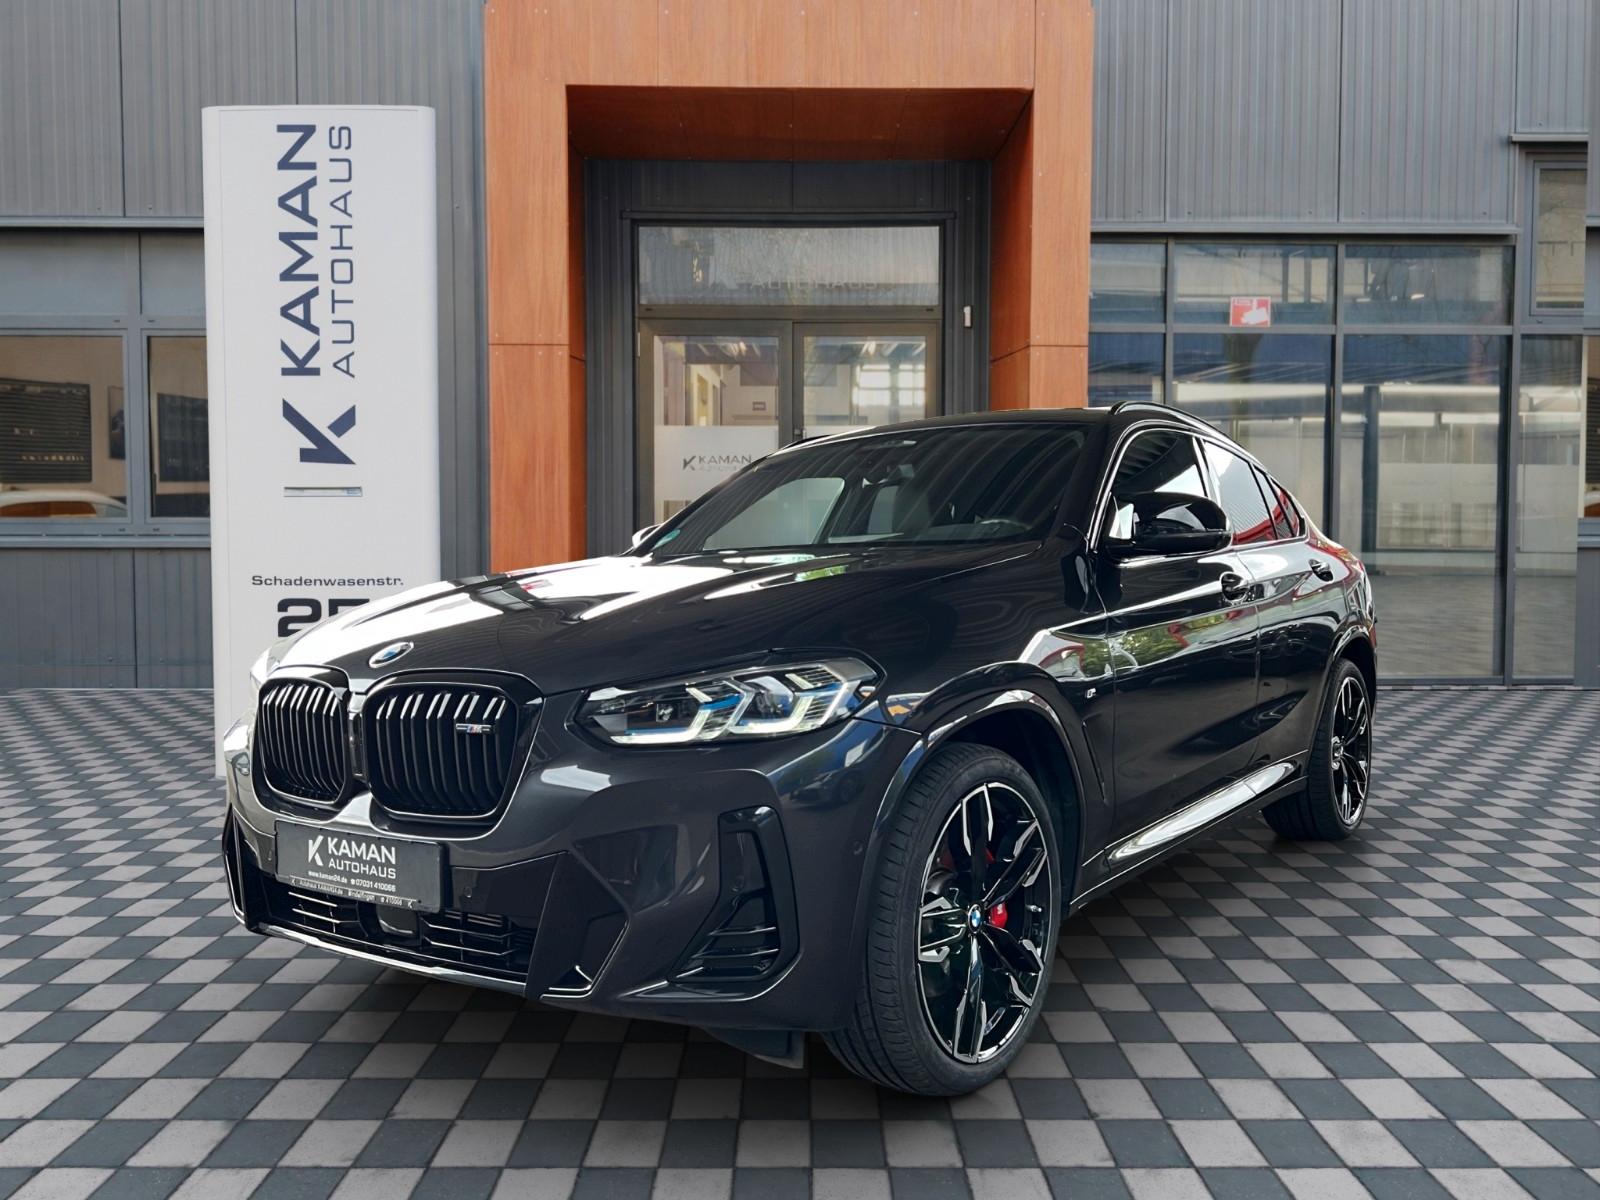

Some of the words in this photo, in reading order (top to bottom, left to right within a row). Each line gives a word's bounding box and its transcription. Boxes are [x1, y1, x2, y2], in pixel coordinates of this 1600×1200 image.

[276, 124, 321, 376] KAMAN
[329, 126, 355, 378] AUTOHAUS
[699, 455, 752, 465] KAMAN
[251, 575, 404, 587] Schadenwasenstr.
[327, 836, 396, 865] KAMAN
[328, 858, 397, 879] AUTOHAUS
